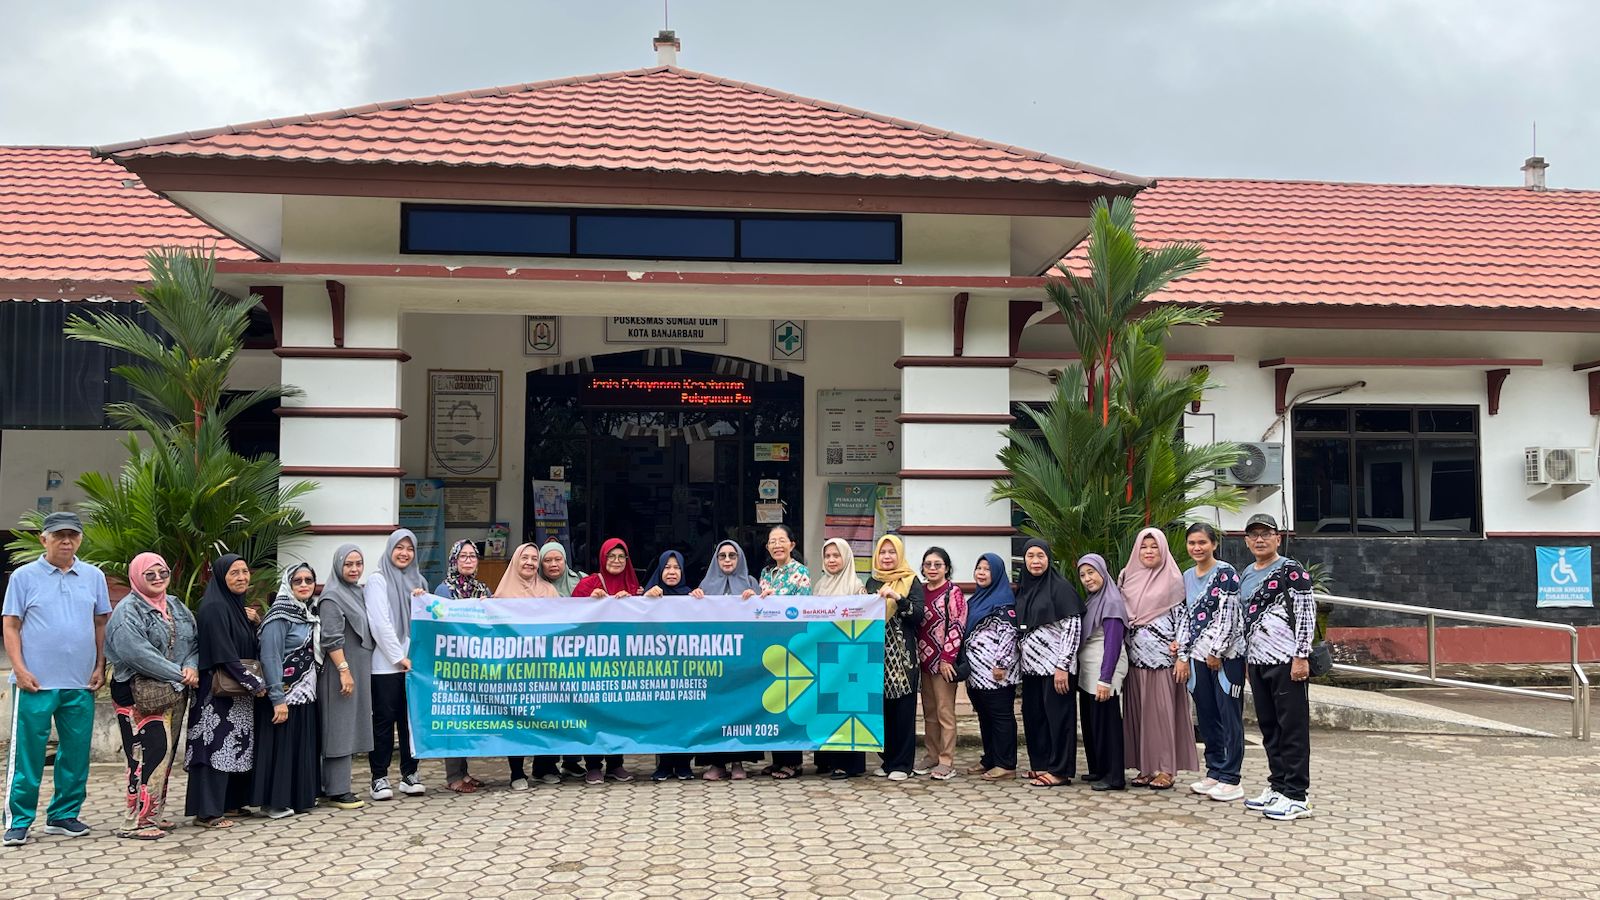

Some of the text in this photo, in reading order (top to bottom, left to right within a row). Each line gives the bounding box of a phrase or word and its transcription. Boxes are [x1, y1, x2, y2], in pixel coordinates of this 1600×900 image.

[613, 316, 718, 326] PUSKESMAS SUNGAI ULIN
[628, 328, 704, 338] KOTA BANJARBARU
[435, 633, 744, 659] PENGABDIAN KEPADA MASYARAKAT
[433, 660, 724, 681] PROGRAM KEMITRAAN MASYARAKAT (PKM)
[478, 682, 526, 693] KOMBINASI
[528, 681, 558, 692] SENAM
[560, 681, 579, 692] KAKI
[581, 680, 619, 691] DIABETES
[621, 680, 638, 691] DAN
[640, 679, 668, 690] SENAM
[670, 678, 708, 689] DIABETES
[431, 689, 707, 705] SEBAGAI ALTERNATIF PENURUNAN KADAR GULA DARAH PADA PASIEN
[431, 704, 470, 716] DIABETES
[473, 704, 508, 716] MELITUS
[510, 705, 528, 716] TIPE
[431, 719, 588, 730] DI PUSKESMAS SUNGAI ULIN
[721, 723, 779, 737] TAHUN 2025
